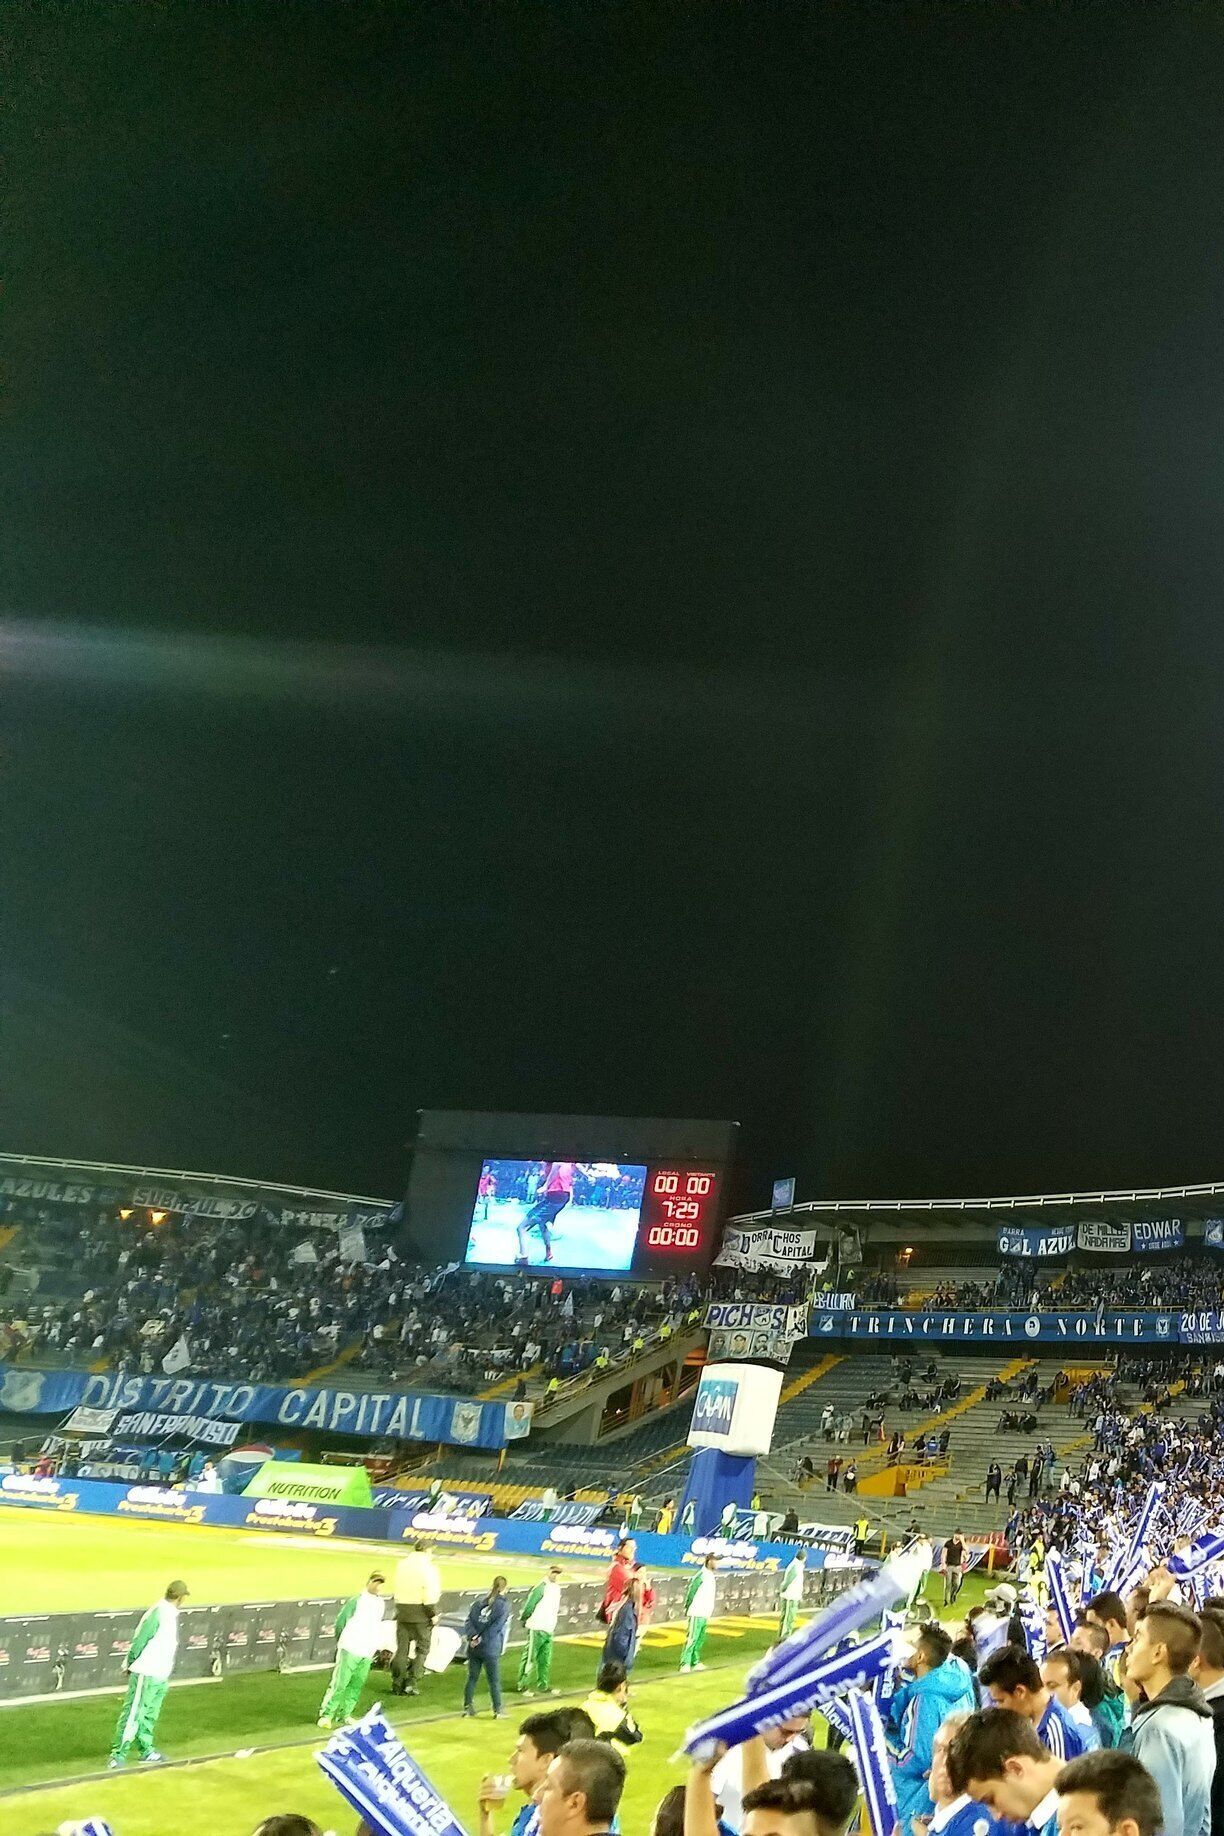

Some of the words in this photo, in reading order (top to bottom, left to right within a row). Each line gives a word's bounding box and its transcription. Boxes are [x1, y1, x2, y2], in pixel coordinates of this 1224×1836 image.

[654, 1176, 678, 1193] 00
[686, 1177, 710, 1194] 00
[662, 1201, 699, 1219] 7:29
[648, 1227, 699, 1246] 00:00
[1082, 1223, 1094, 1235] DE
[1133, 1219, 1181, 1240] EDWAR
[1037, 1233, 1077, 1256] AZUL
[849, 1315, 1012, 1336] TRINCHERA
[1057, 1315, 1145, 1337] NORTE
[1181, 1312, 1196, 1332] 20
[1199, 1312, 1212, 1331] DE
[81, 1375, 256, 1418] DISTRITO
[277, 1388, 425, 1439] CAPITAL
[267, 1481, 342, 1500] NUTRITION
